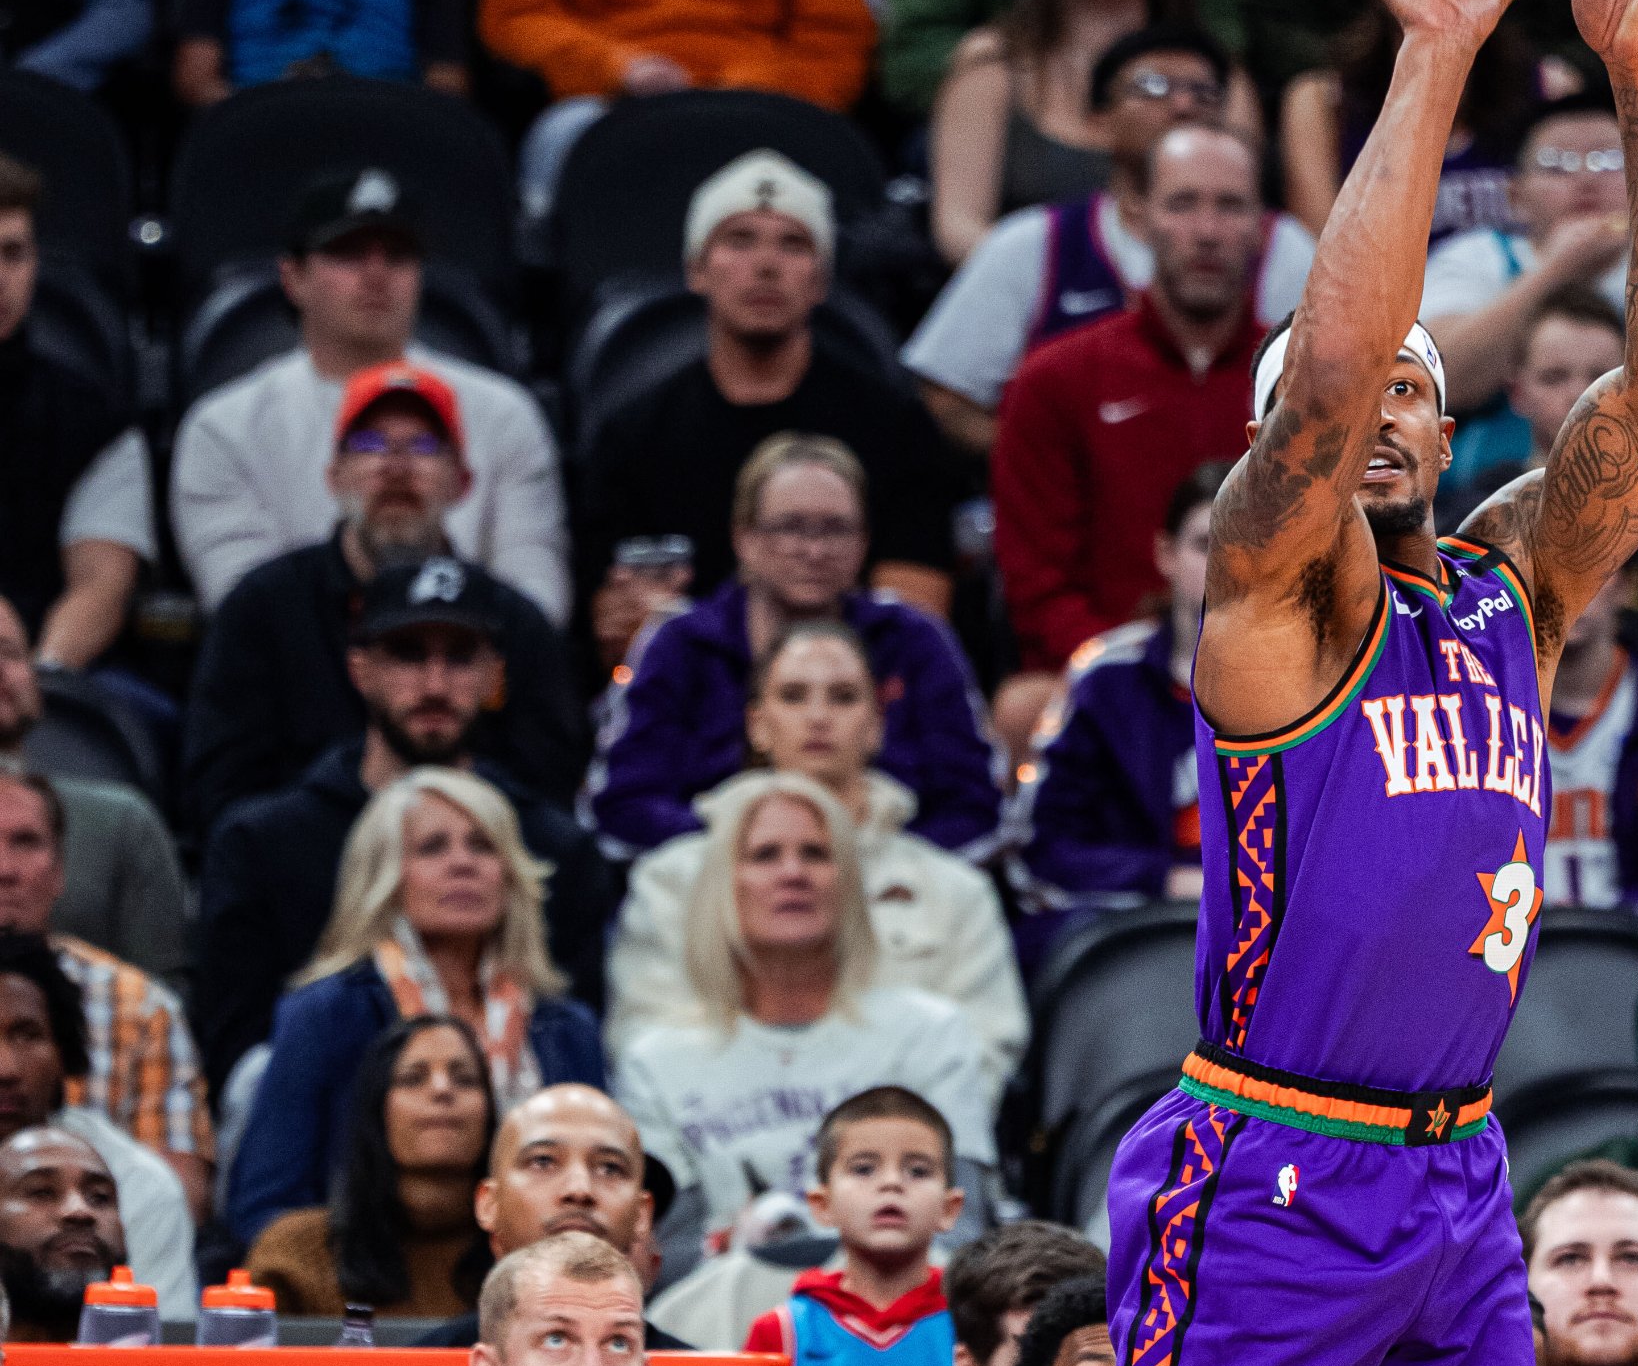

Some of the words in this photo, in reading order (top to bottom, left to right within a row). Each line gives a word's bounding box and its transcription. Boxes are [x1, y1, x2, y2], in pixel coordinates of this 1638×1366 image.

[1453, 589, 1514, 631] ayPal
[1439, 639, 1497, 687] THE
[1361, 693, 1543, 819] VALLEY
[1483, 861, 1536, 974] 3
